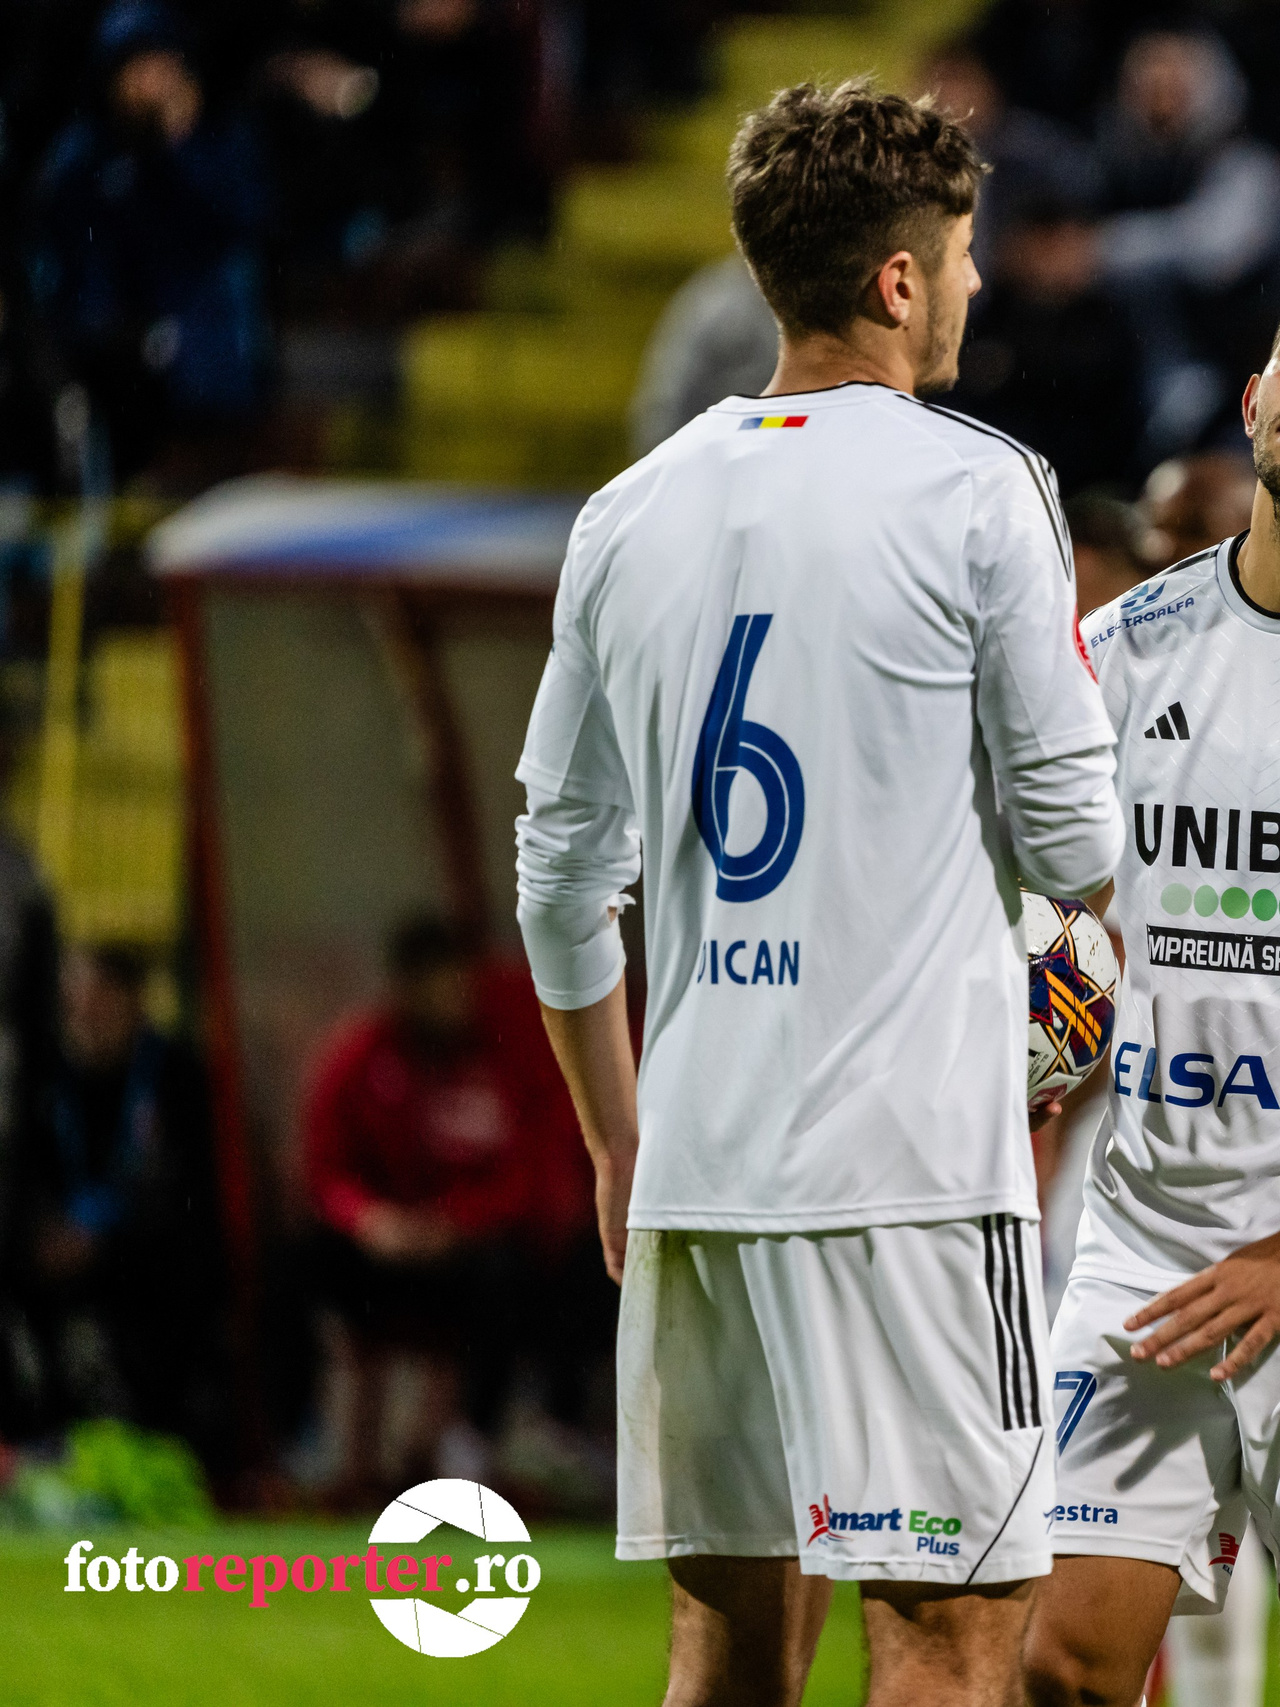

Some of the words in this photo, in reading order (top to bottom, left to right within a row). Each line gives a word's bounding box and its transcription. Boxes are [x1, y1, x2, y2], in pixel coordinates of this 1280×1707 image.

[692, 614, 805, 902] 6
[697, 939, 800, 986] ICAN
[1149, 928, 1256, 970] MPREUNĂ
[908, 1510, 962, 1536] Eco
[917, 1536, 960, 1556] Plus
